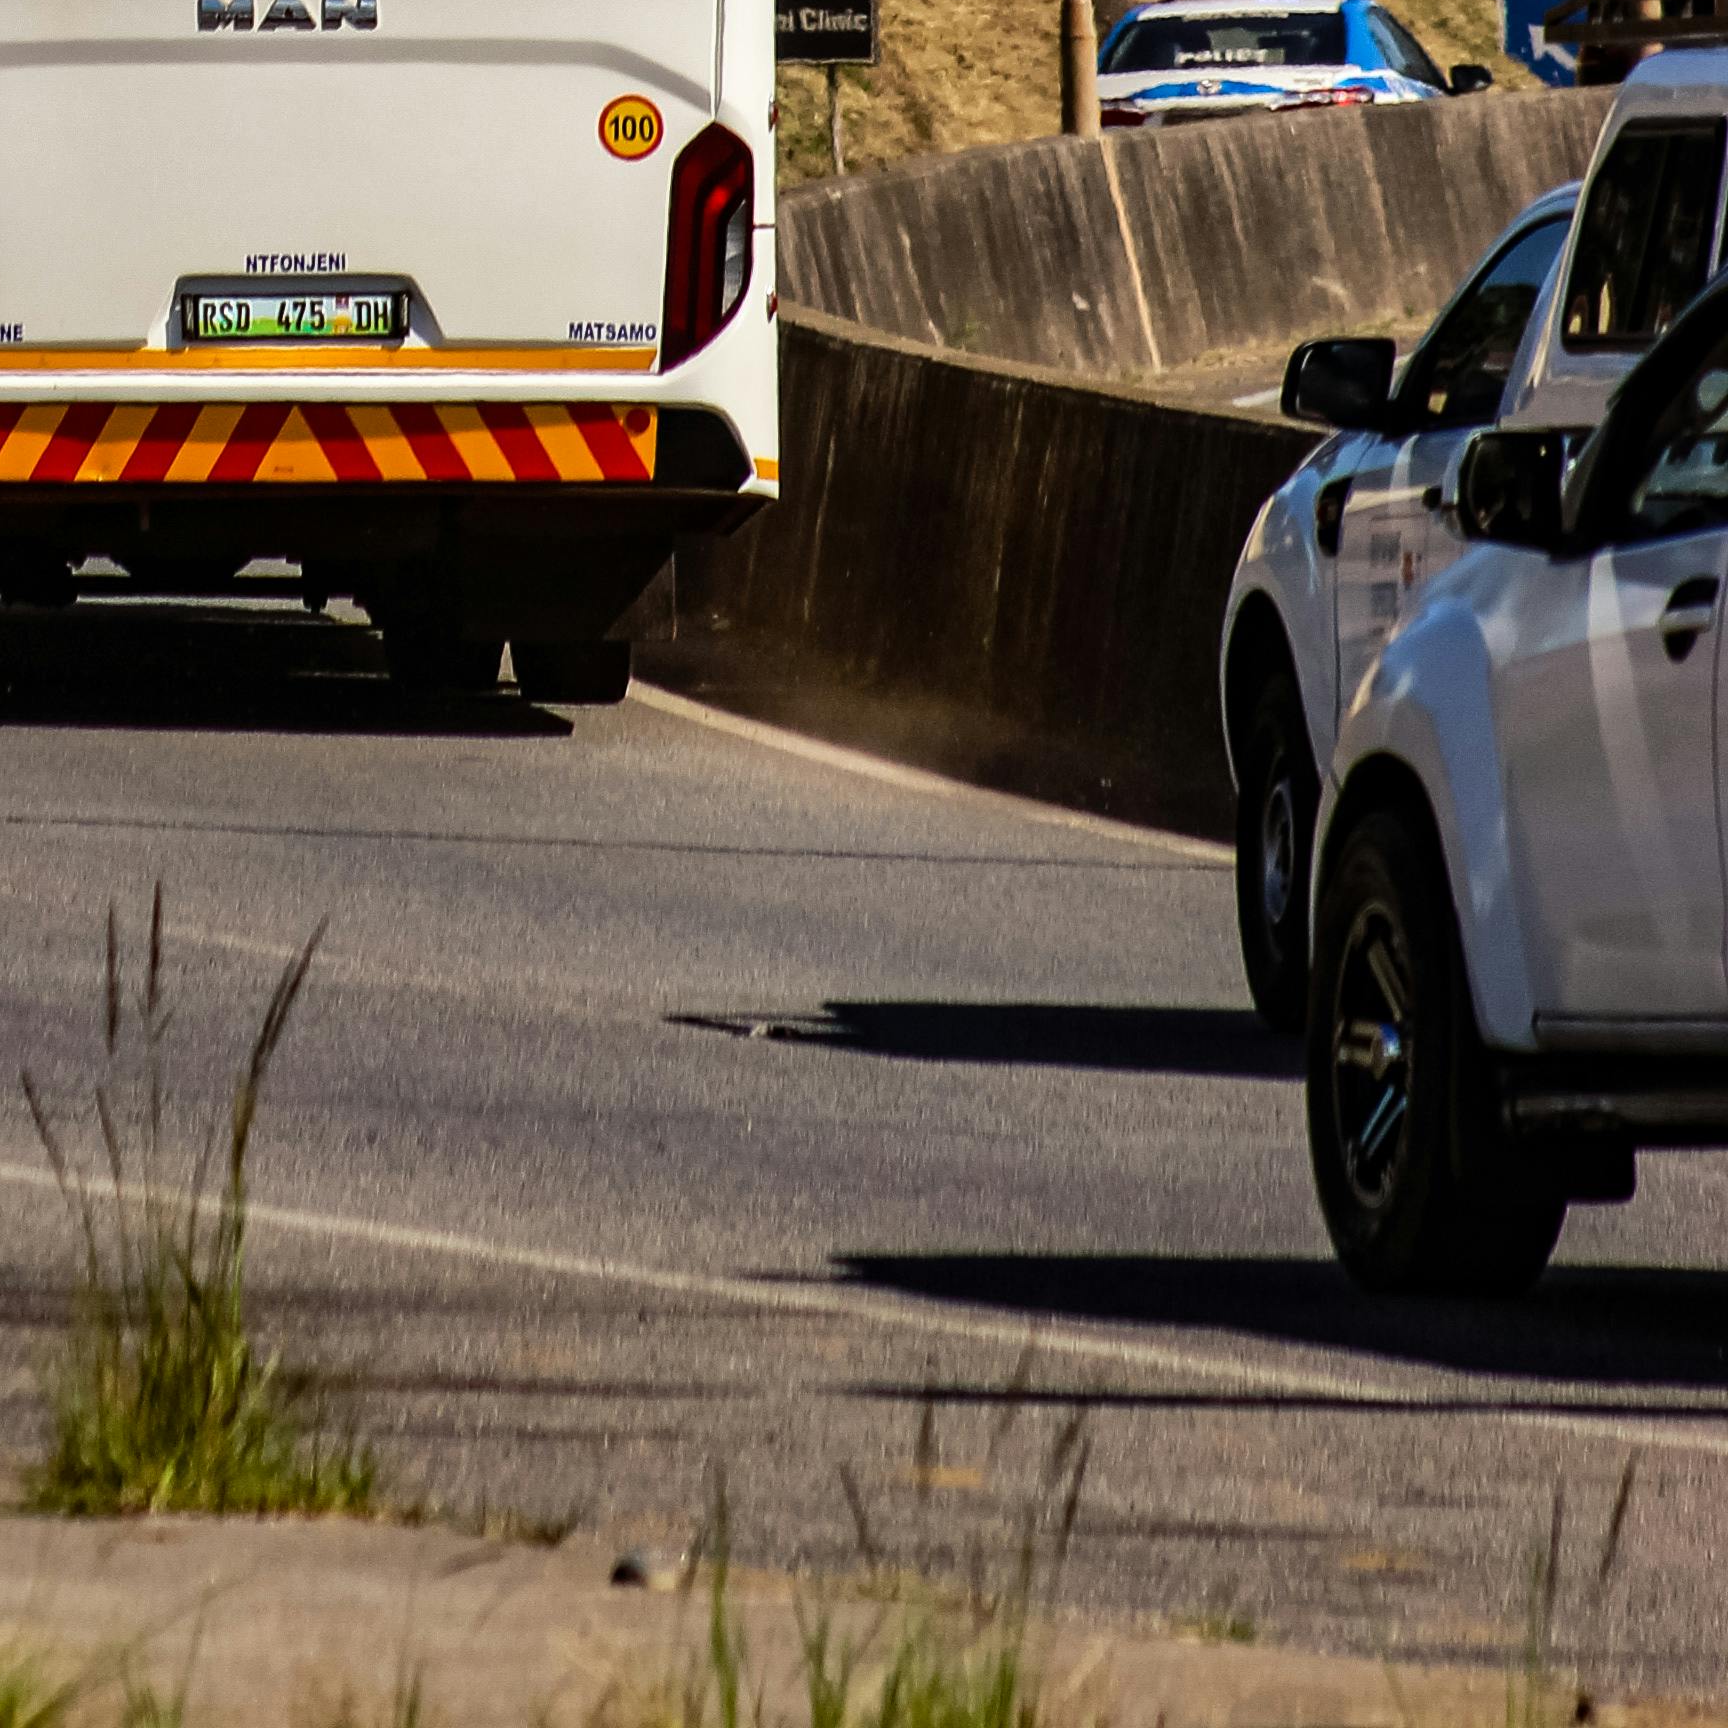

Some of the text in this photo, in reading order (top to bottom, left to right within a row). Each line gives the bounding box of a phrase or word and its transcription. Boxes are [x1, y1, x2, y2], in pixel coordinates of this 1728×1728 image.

[799, 6, 868, 33] Clinic
[609, 114, 654, 142] 100
[245, 252, 347, 273] NTFONJENI
[202, 299, 390, 334] RSD 475 DH
[569, 322, 657, 341] MATSAMO
